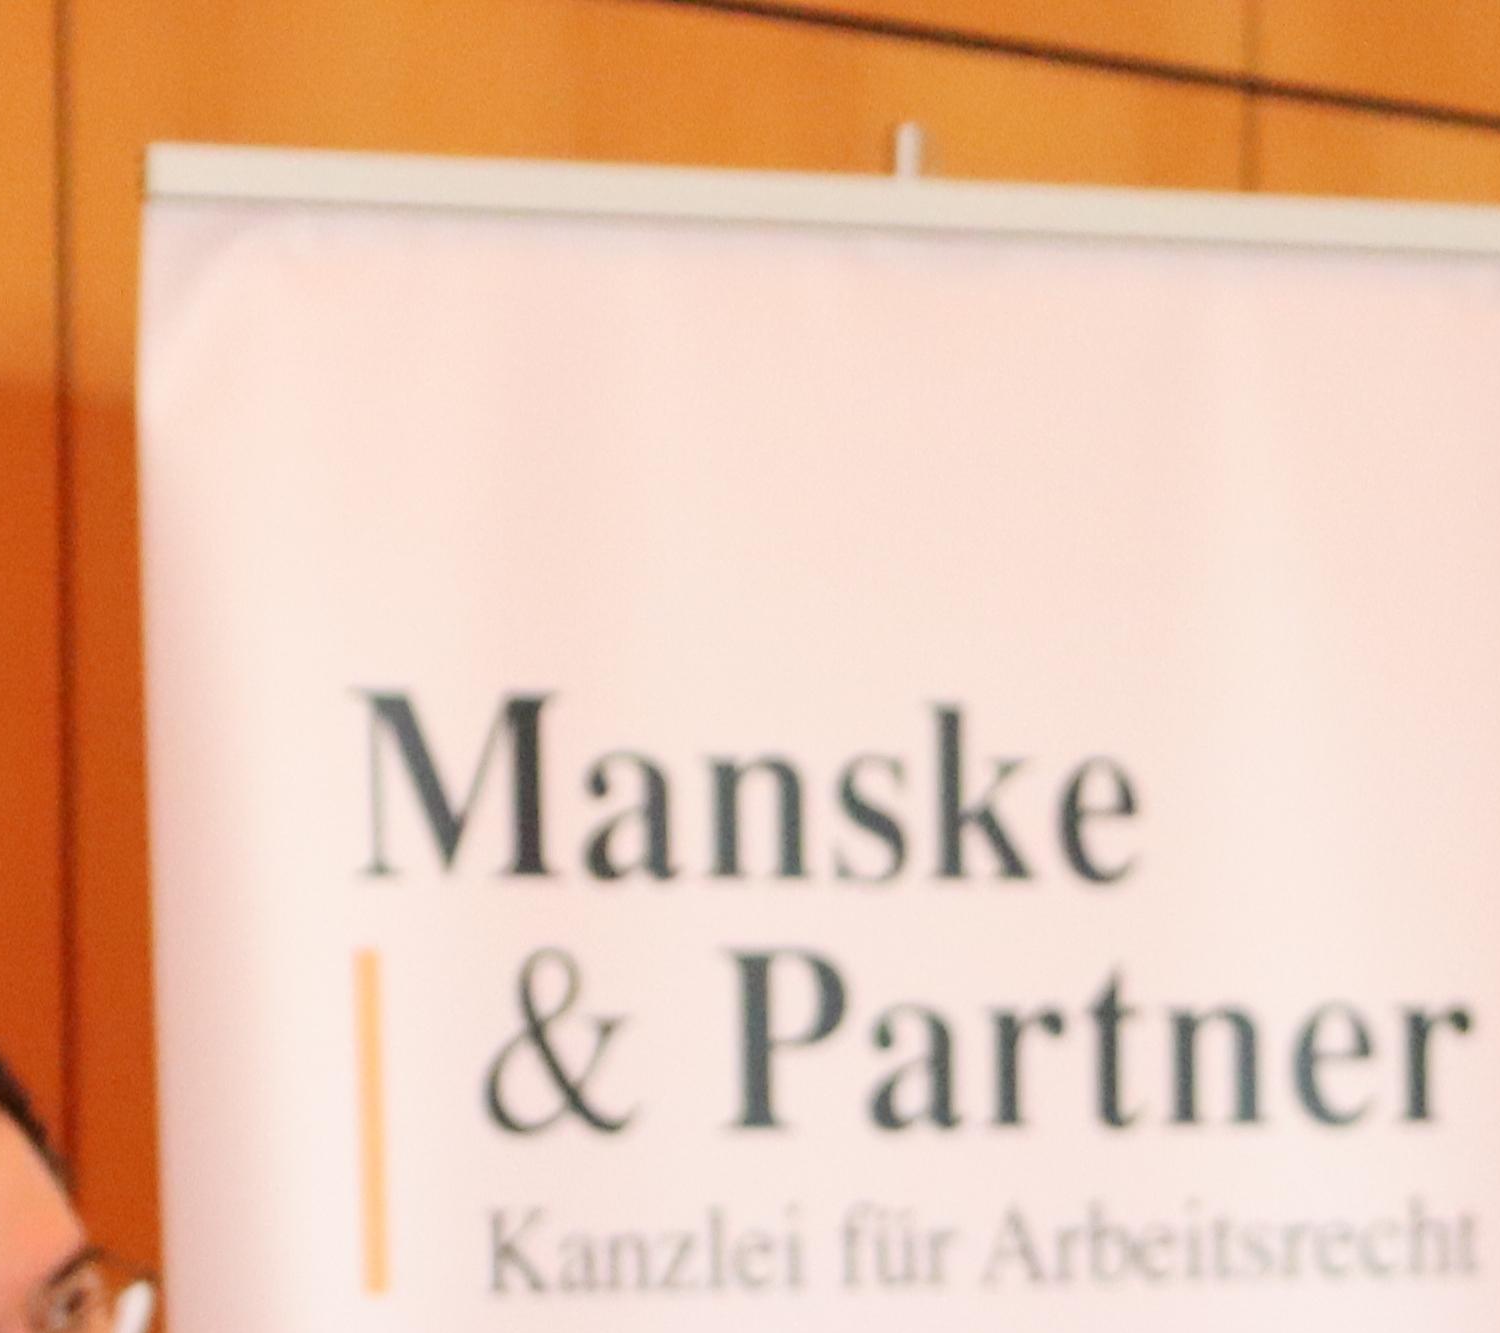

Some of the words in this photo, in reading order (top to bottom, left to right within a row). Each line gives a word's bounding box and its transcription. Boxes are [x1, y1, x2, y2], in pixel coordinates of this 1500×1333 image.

[350, 683, 1145, 886] Manske
[482, 945, 640, 1138] &
[716, 945, 1474, 1132] Partner
[485, 1205, 806, 1298] Kanzlei
[838, 1203, 958, 1291] für
[978, 1195, 1482, 1287] Arbeitsrecht
